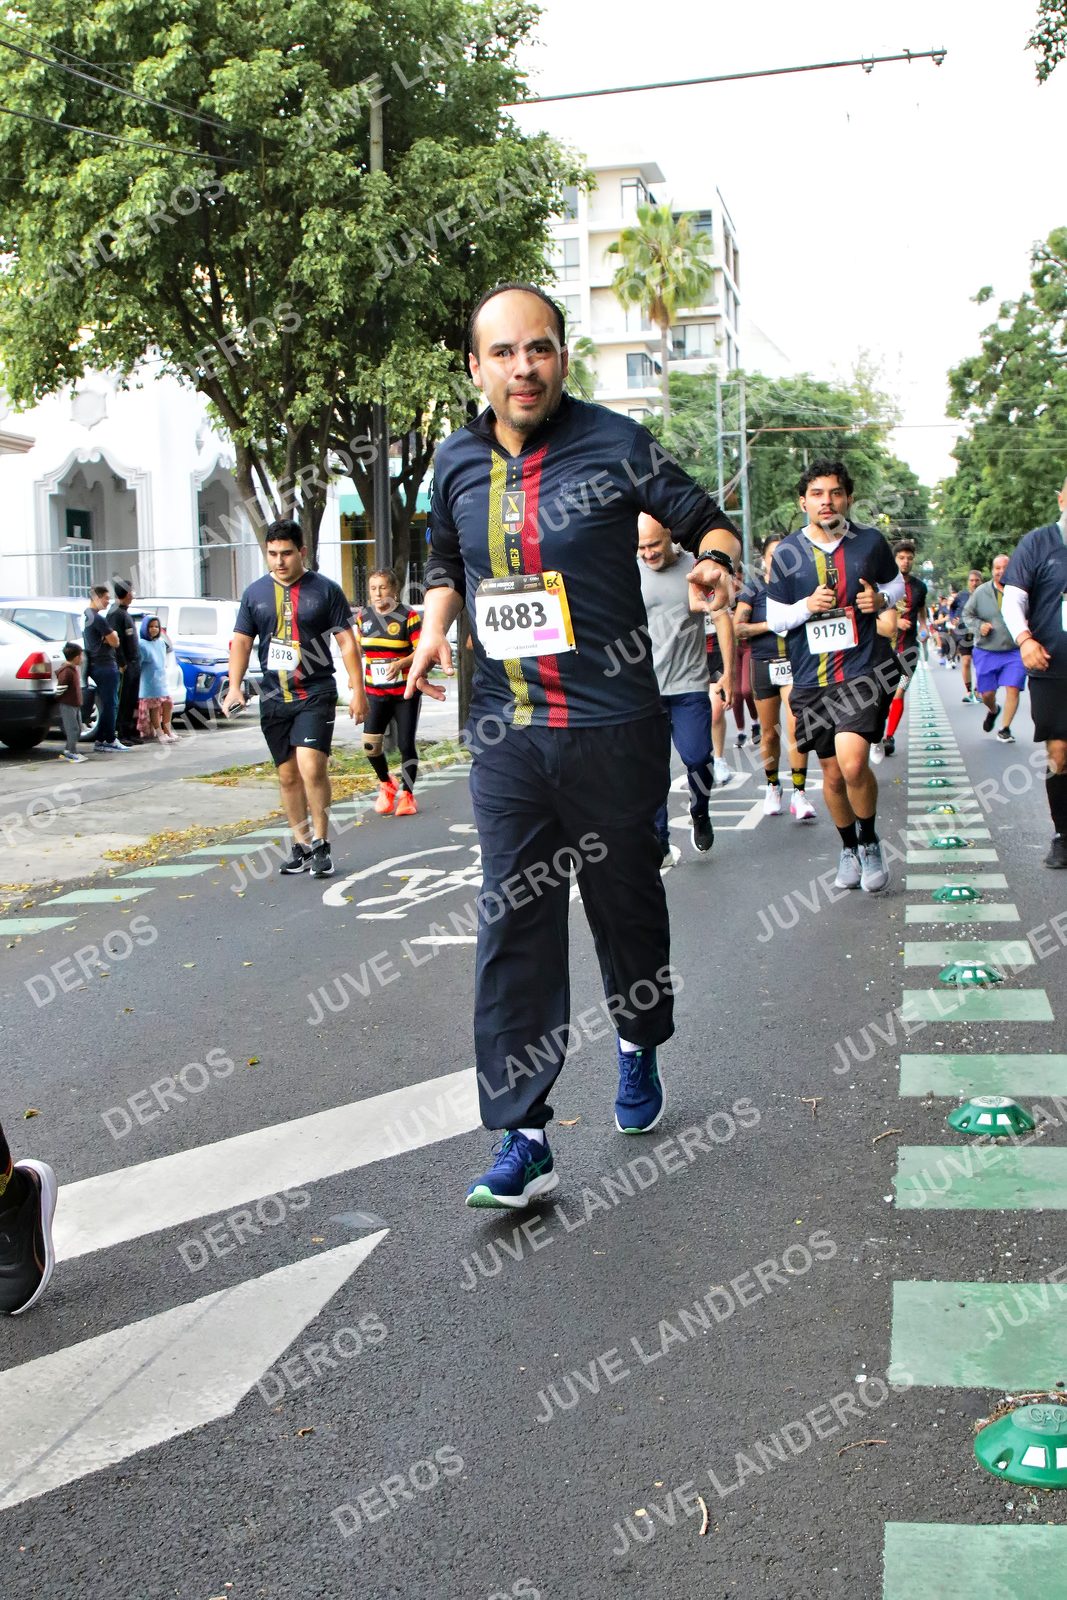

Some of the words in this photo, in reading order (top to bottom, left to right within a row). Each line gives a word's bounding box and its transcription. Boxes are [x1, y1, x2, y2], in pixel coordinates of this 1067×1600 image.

[485, 601, 547, 632] 4883
[813, 622, 847, 640] 9178
[775, 665, 792, 676] 705
